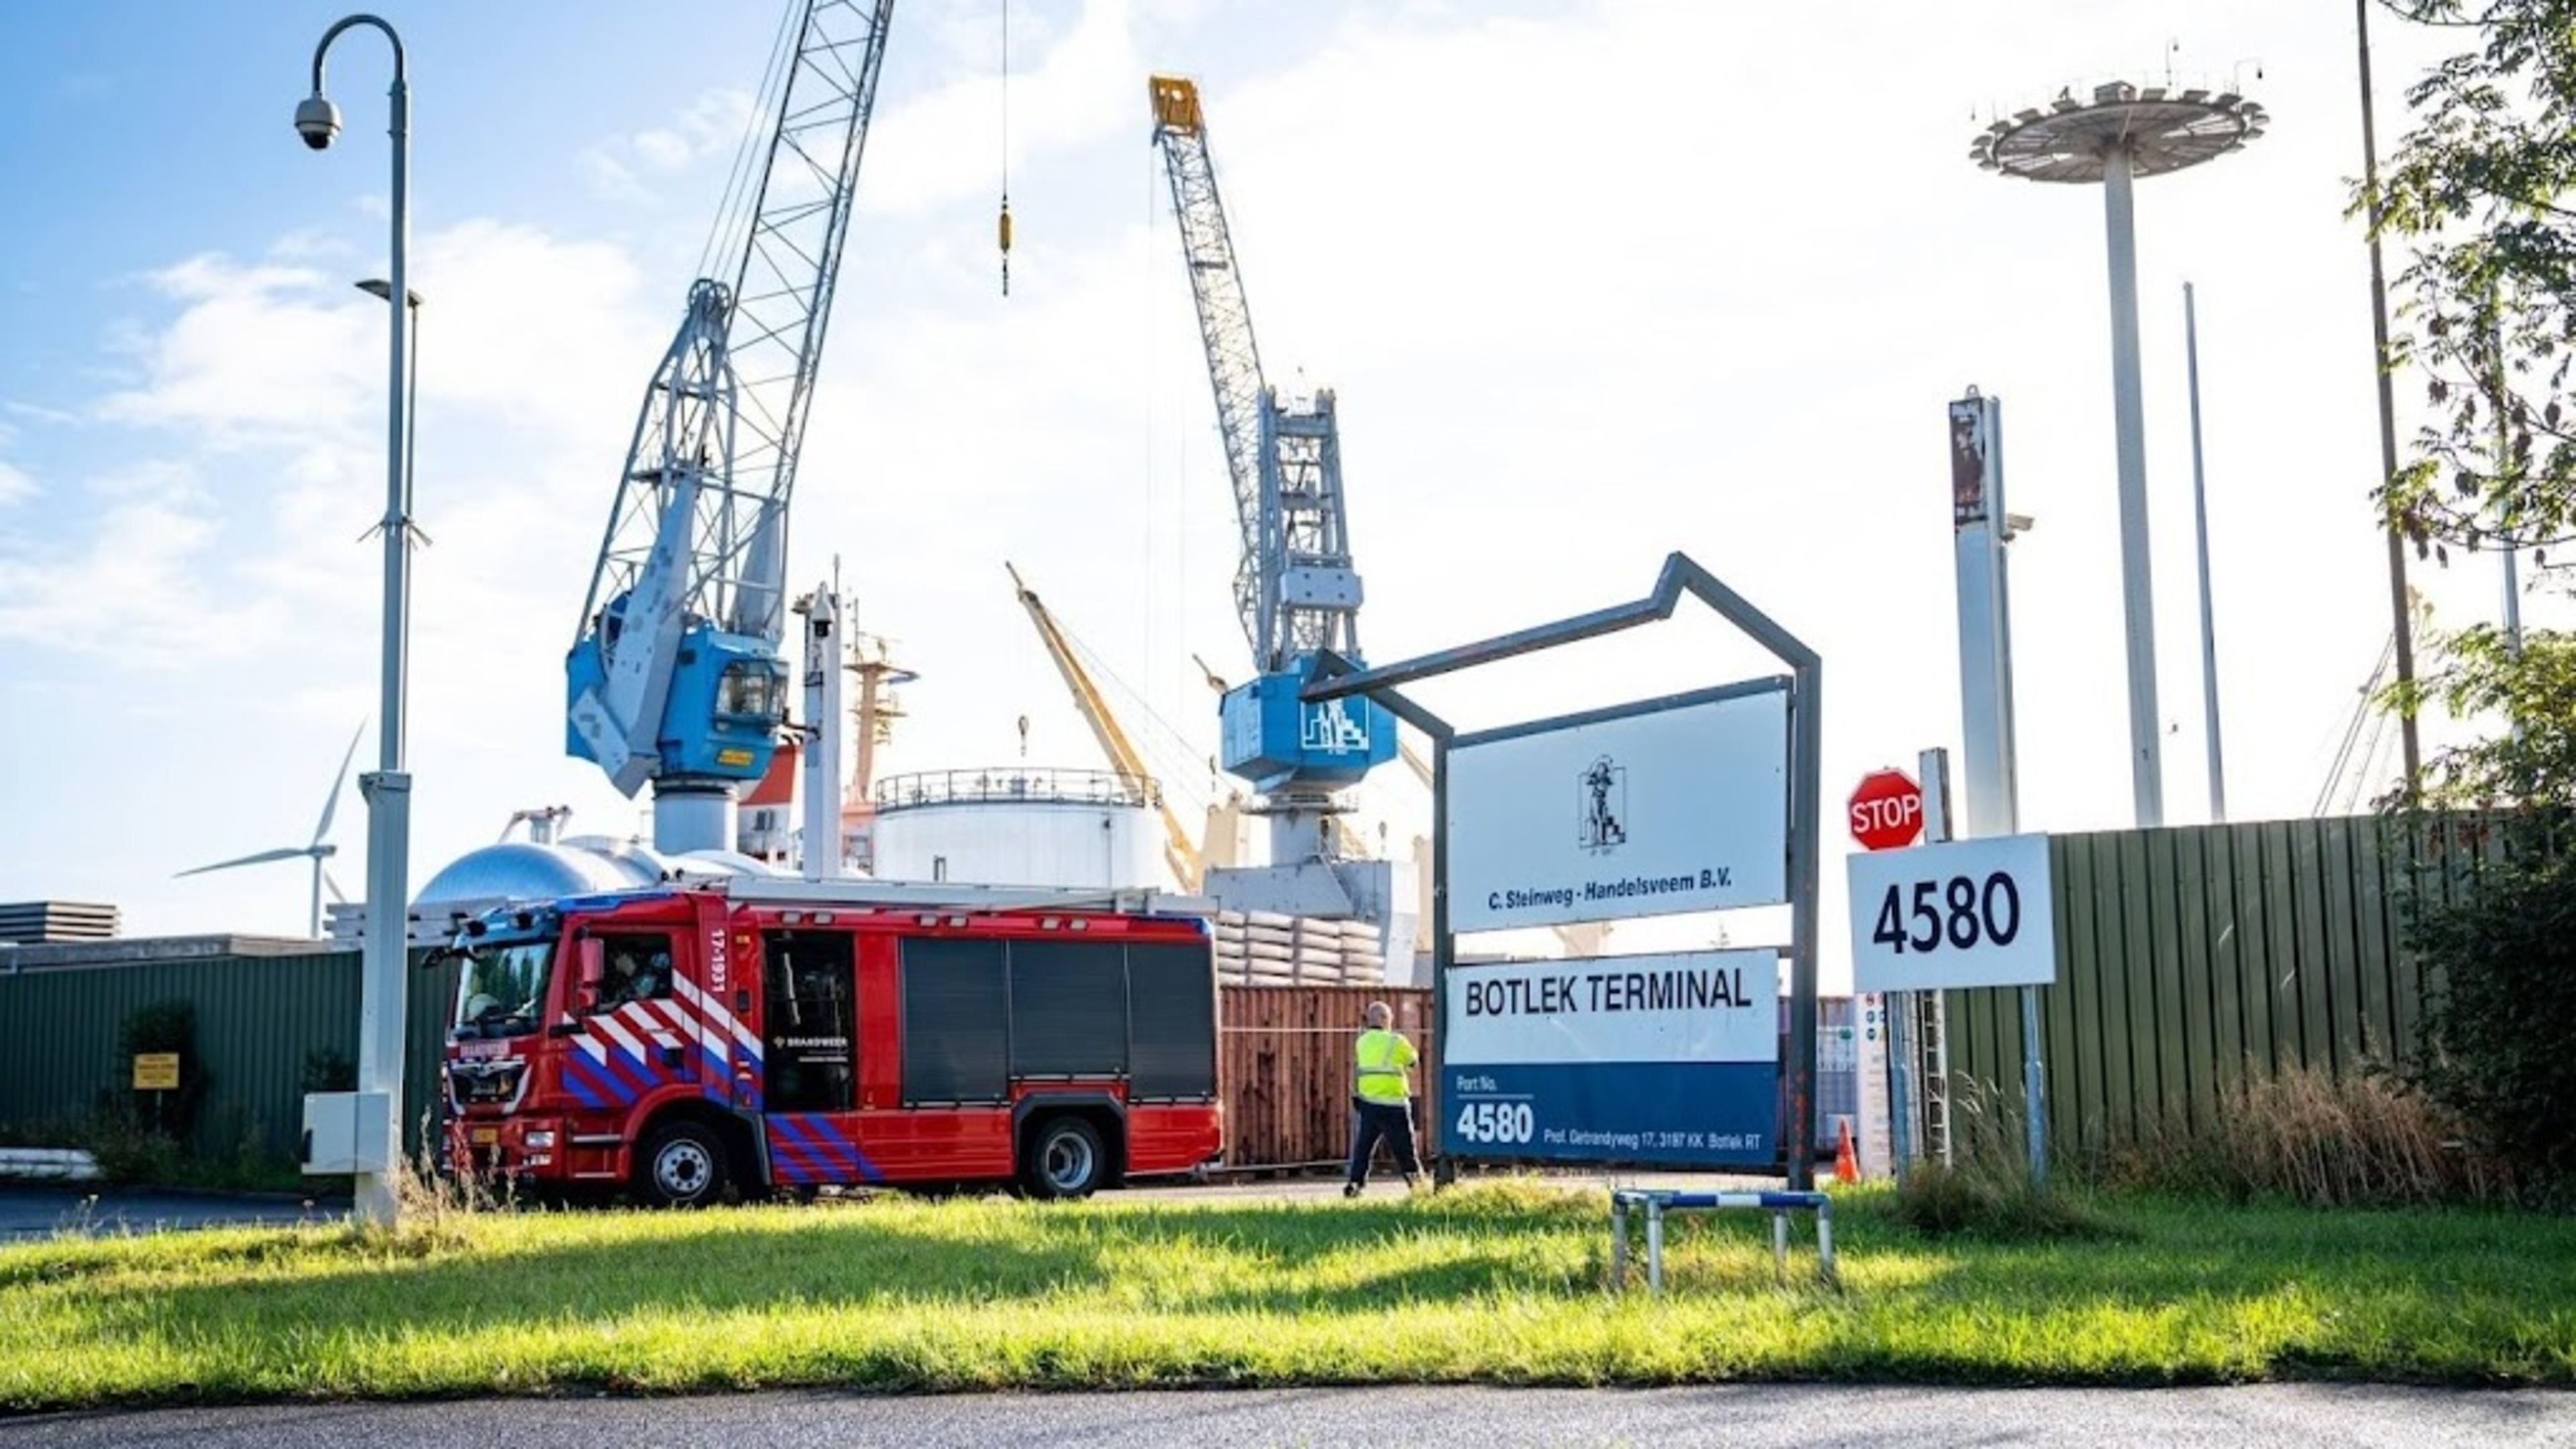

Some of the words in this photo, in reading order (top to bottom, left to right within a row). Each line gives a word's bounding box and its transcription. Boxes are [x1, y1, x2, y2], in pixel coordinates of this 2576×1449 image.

[1852, 794, 1919, 833] STOP
[1489, 892, 1503, 910] C.
[1506, 888, 1573, 908] Steinweg
[1584, 875, 1694, 901] Handelsveem
[1700, 867, 1732, 889] B.V.
[1873, 870, 2020, 954] 4580
[711, 928, 725, 991] 17-1931
[1466, 975, 1578, 1016] BOTLEK
[1587, 968, 1752, 1012] TERMINAL
[787, 1036, 848, 1047] BRANDWEER
[1456, 1103, 1534, 1143] 4580
